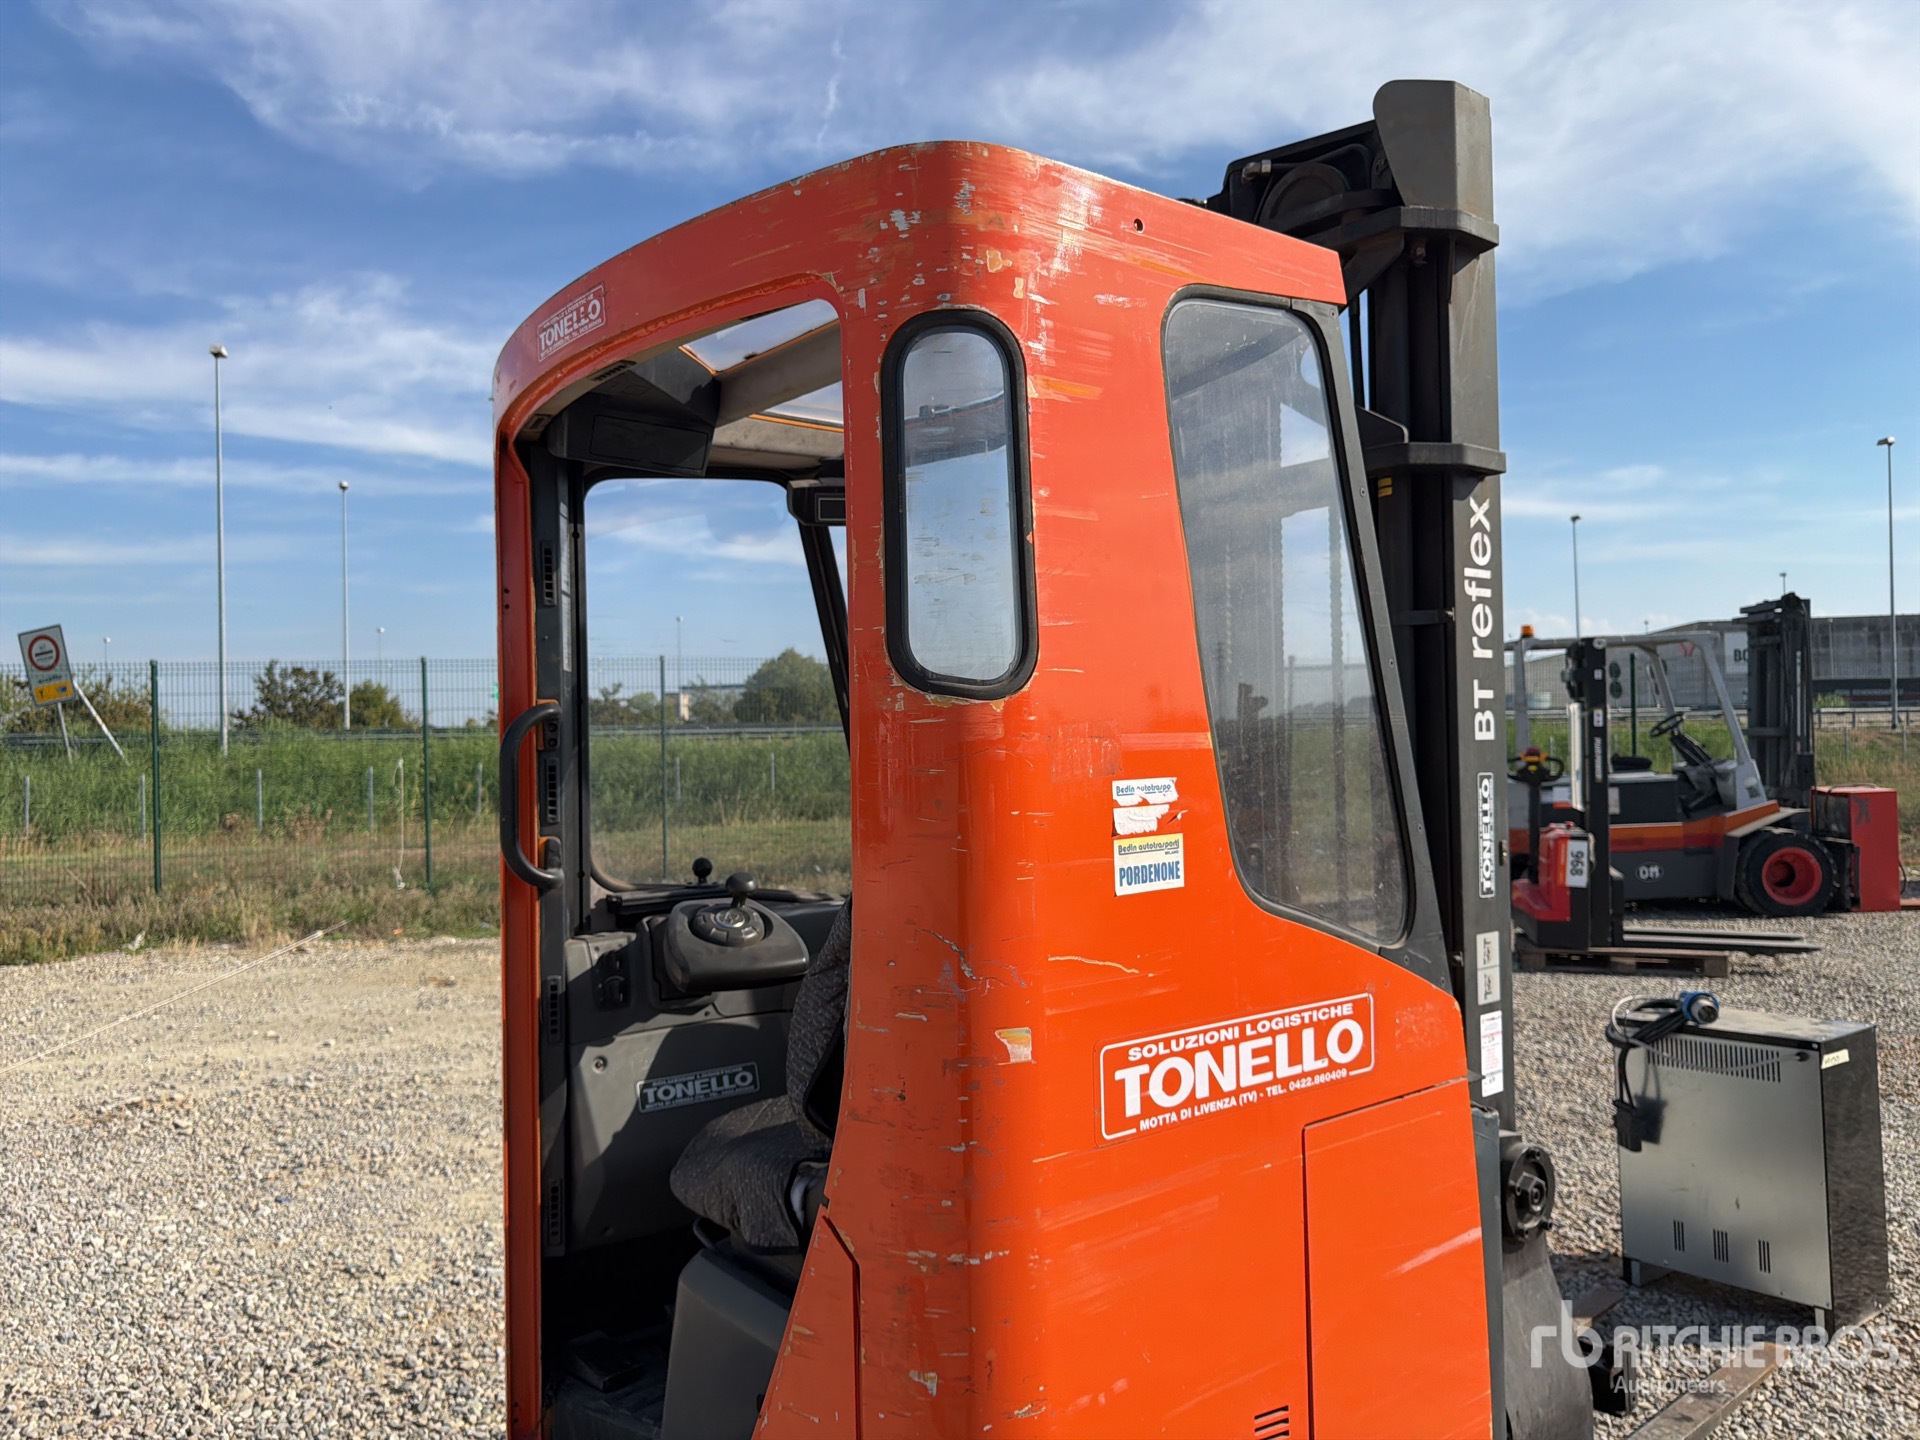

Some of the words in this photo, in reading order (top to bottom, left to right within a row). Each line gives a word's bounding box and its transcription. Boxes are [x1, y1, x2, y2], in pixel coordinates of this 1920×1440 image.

[540, 299, 600, 350] TONELLO
[1464, 496, 1493, 659] reflex
[1474, 679, 1495, 741] BT
[1116, 785, 1135, 796] Bedin
[1118, 844, 1137, 854] Bedin
[1481, 778, 1491, 892] TONELLO
[1119, 861, 1180, 887] PORDENONE
[1128, 1026, 1240, 1061] SOLUZIONI
[1246, 1003, 1353, 1036] LOGISTICHE
[643, 1071, 753, 1104] TONELLO
[1115, 1018, 1364, 1118] TONELLO
[1139, 1111, 1178, 1131] MOTTA
[1180, 1107, 1192, 1121] DI
[1194, 1096, 1237, 1116] LIVENZA
[1239, 1090, 1258, 1107] (TV)
[1265, 1084, 1287, 1098] TEL.
[1288, 1067, 1347, 1092] 0422.860409
